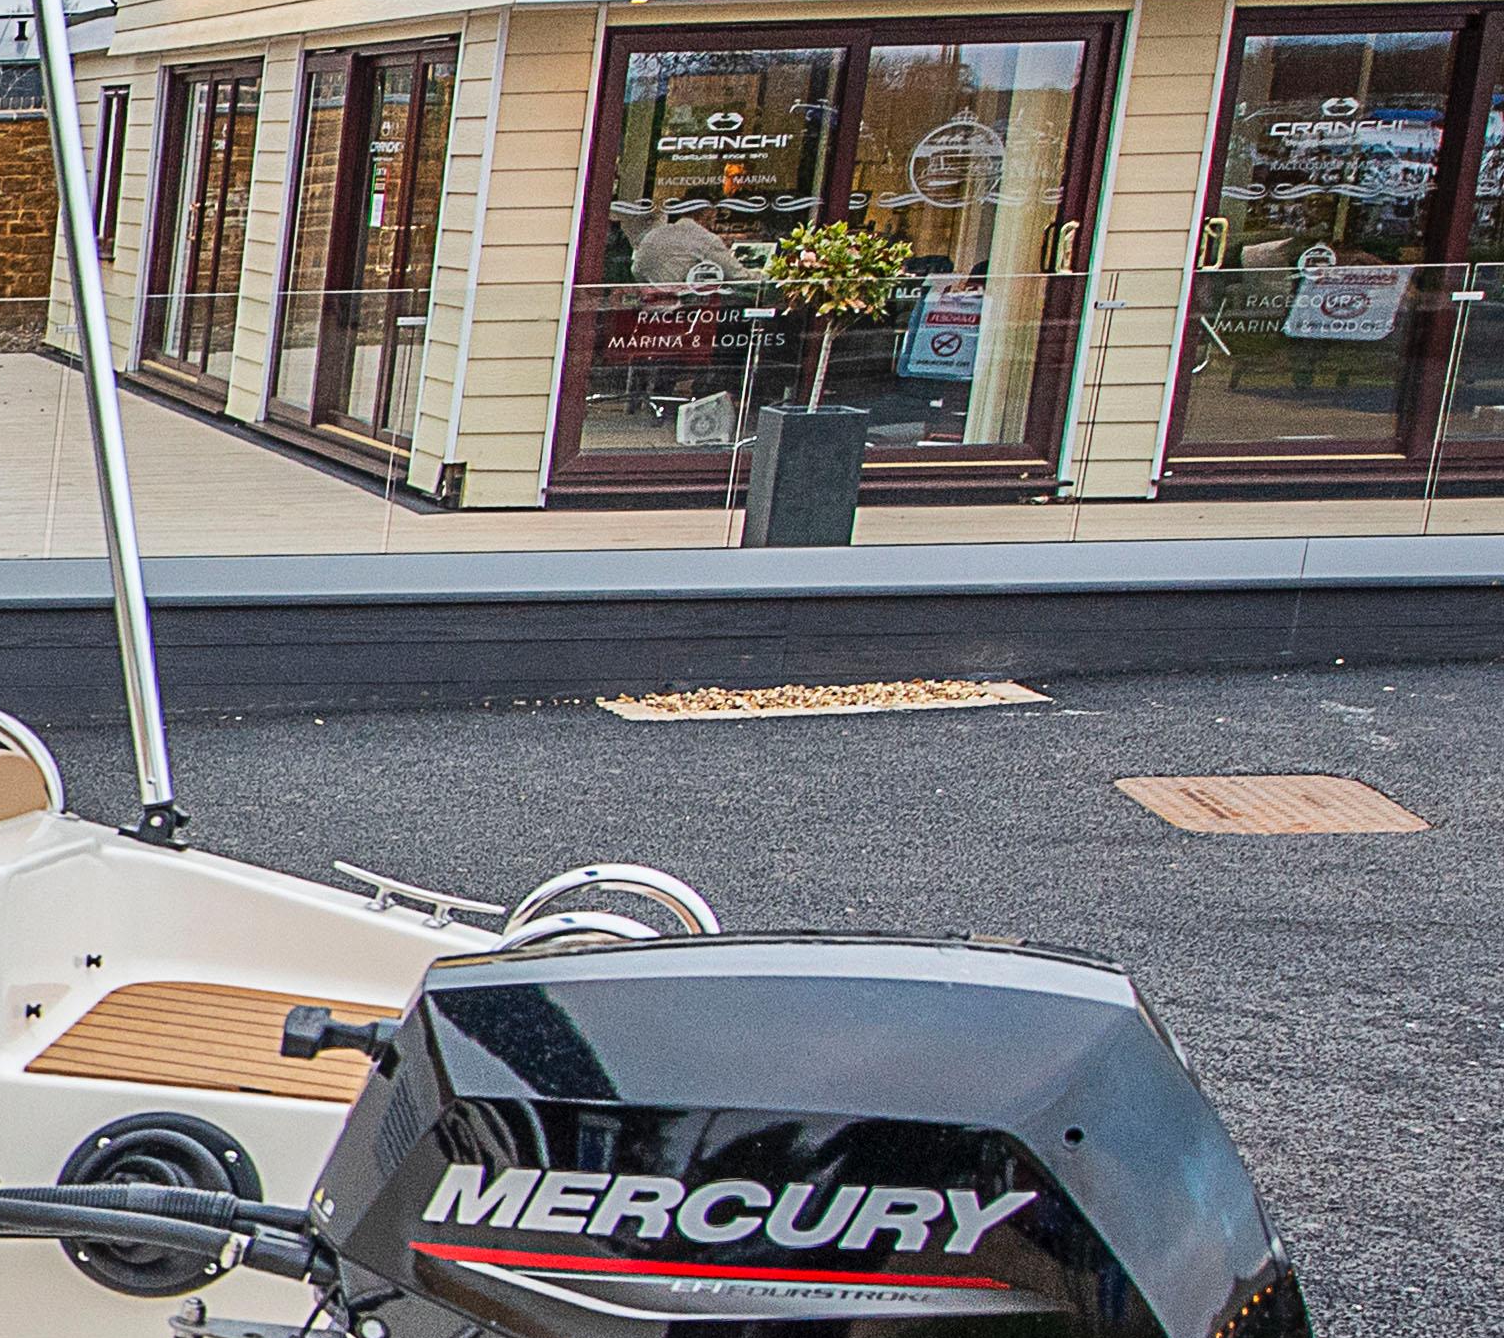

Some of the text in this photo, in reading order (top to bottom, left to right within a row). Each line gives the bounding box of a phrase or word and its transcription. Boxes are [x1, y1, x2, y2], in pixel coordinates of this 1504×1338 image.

[1269, 120, 1403, 136] CRANCHI
[657, 134, 788, 151] CRANCHI
[732, 174, 777, 185] MARINA
[638, 308, 753, 324] RACECOURS
[1215, 319, 1290, 334] MARINA
[1320, 318, 1395, 334] LODGES
[607, 332, 786, 349] MARINA & LODGES
[421, 1162, 1039, 1256] MERCURY
[726, 1284, 938, 1303] FOURSTROKE
